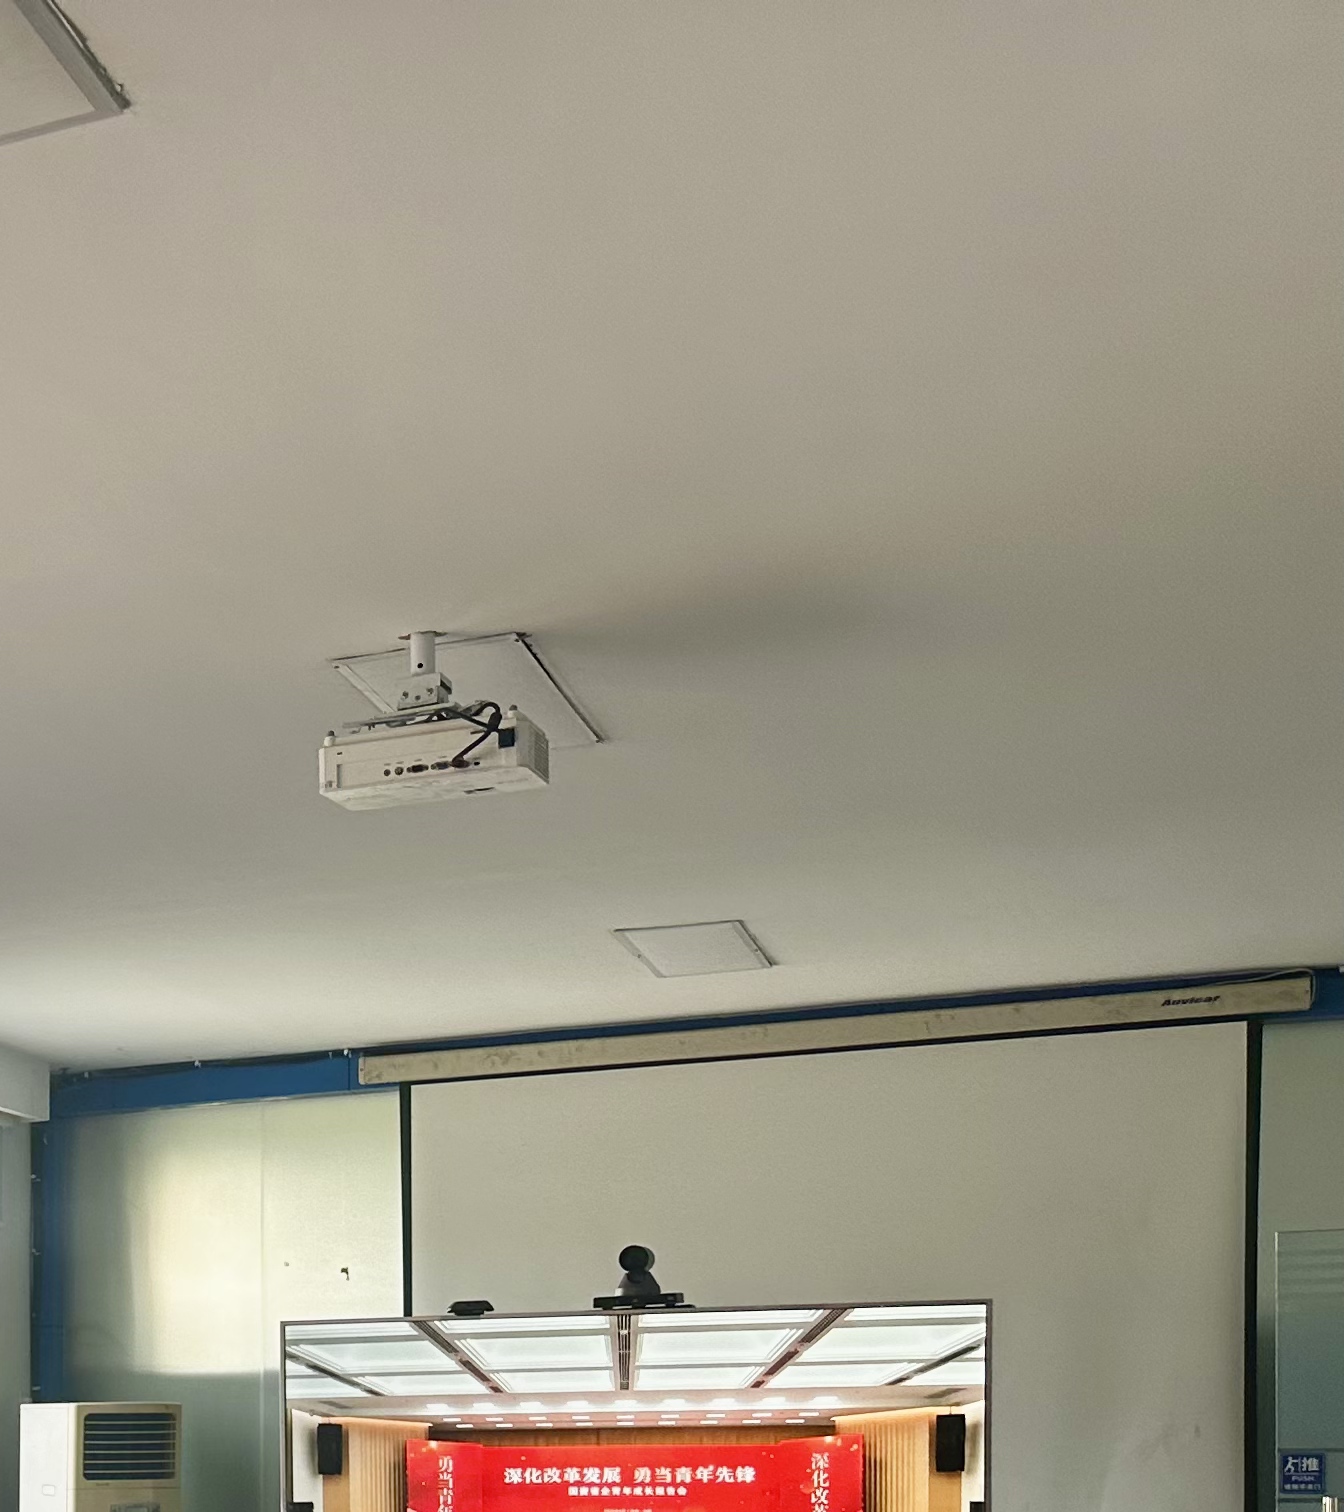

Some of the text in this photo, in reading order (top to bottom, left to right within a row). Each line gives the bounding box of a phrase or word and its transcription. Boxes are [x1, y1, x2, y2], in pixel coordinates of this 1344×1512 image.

[503, 1465, 756, 1485] 深化改革发展 勇当青年先锋
